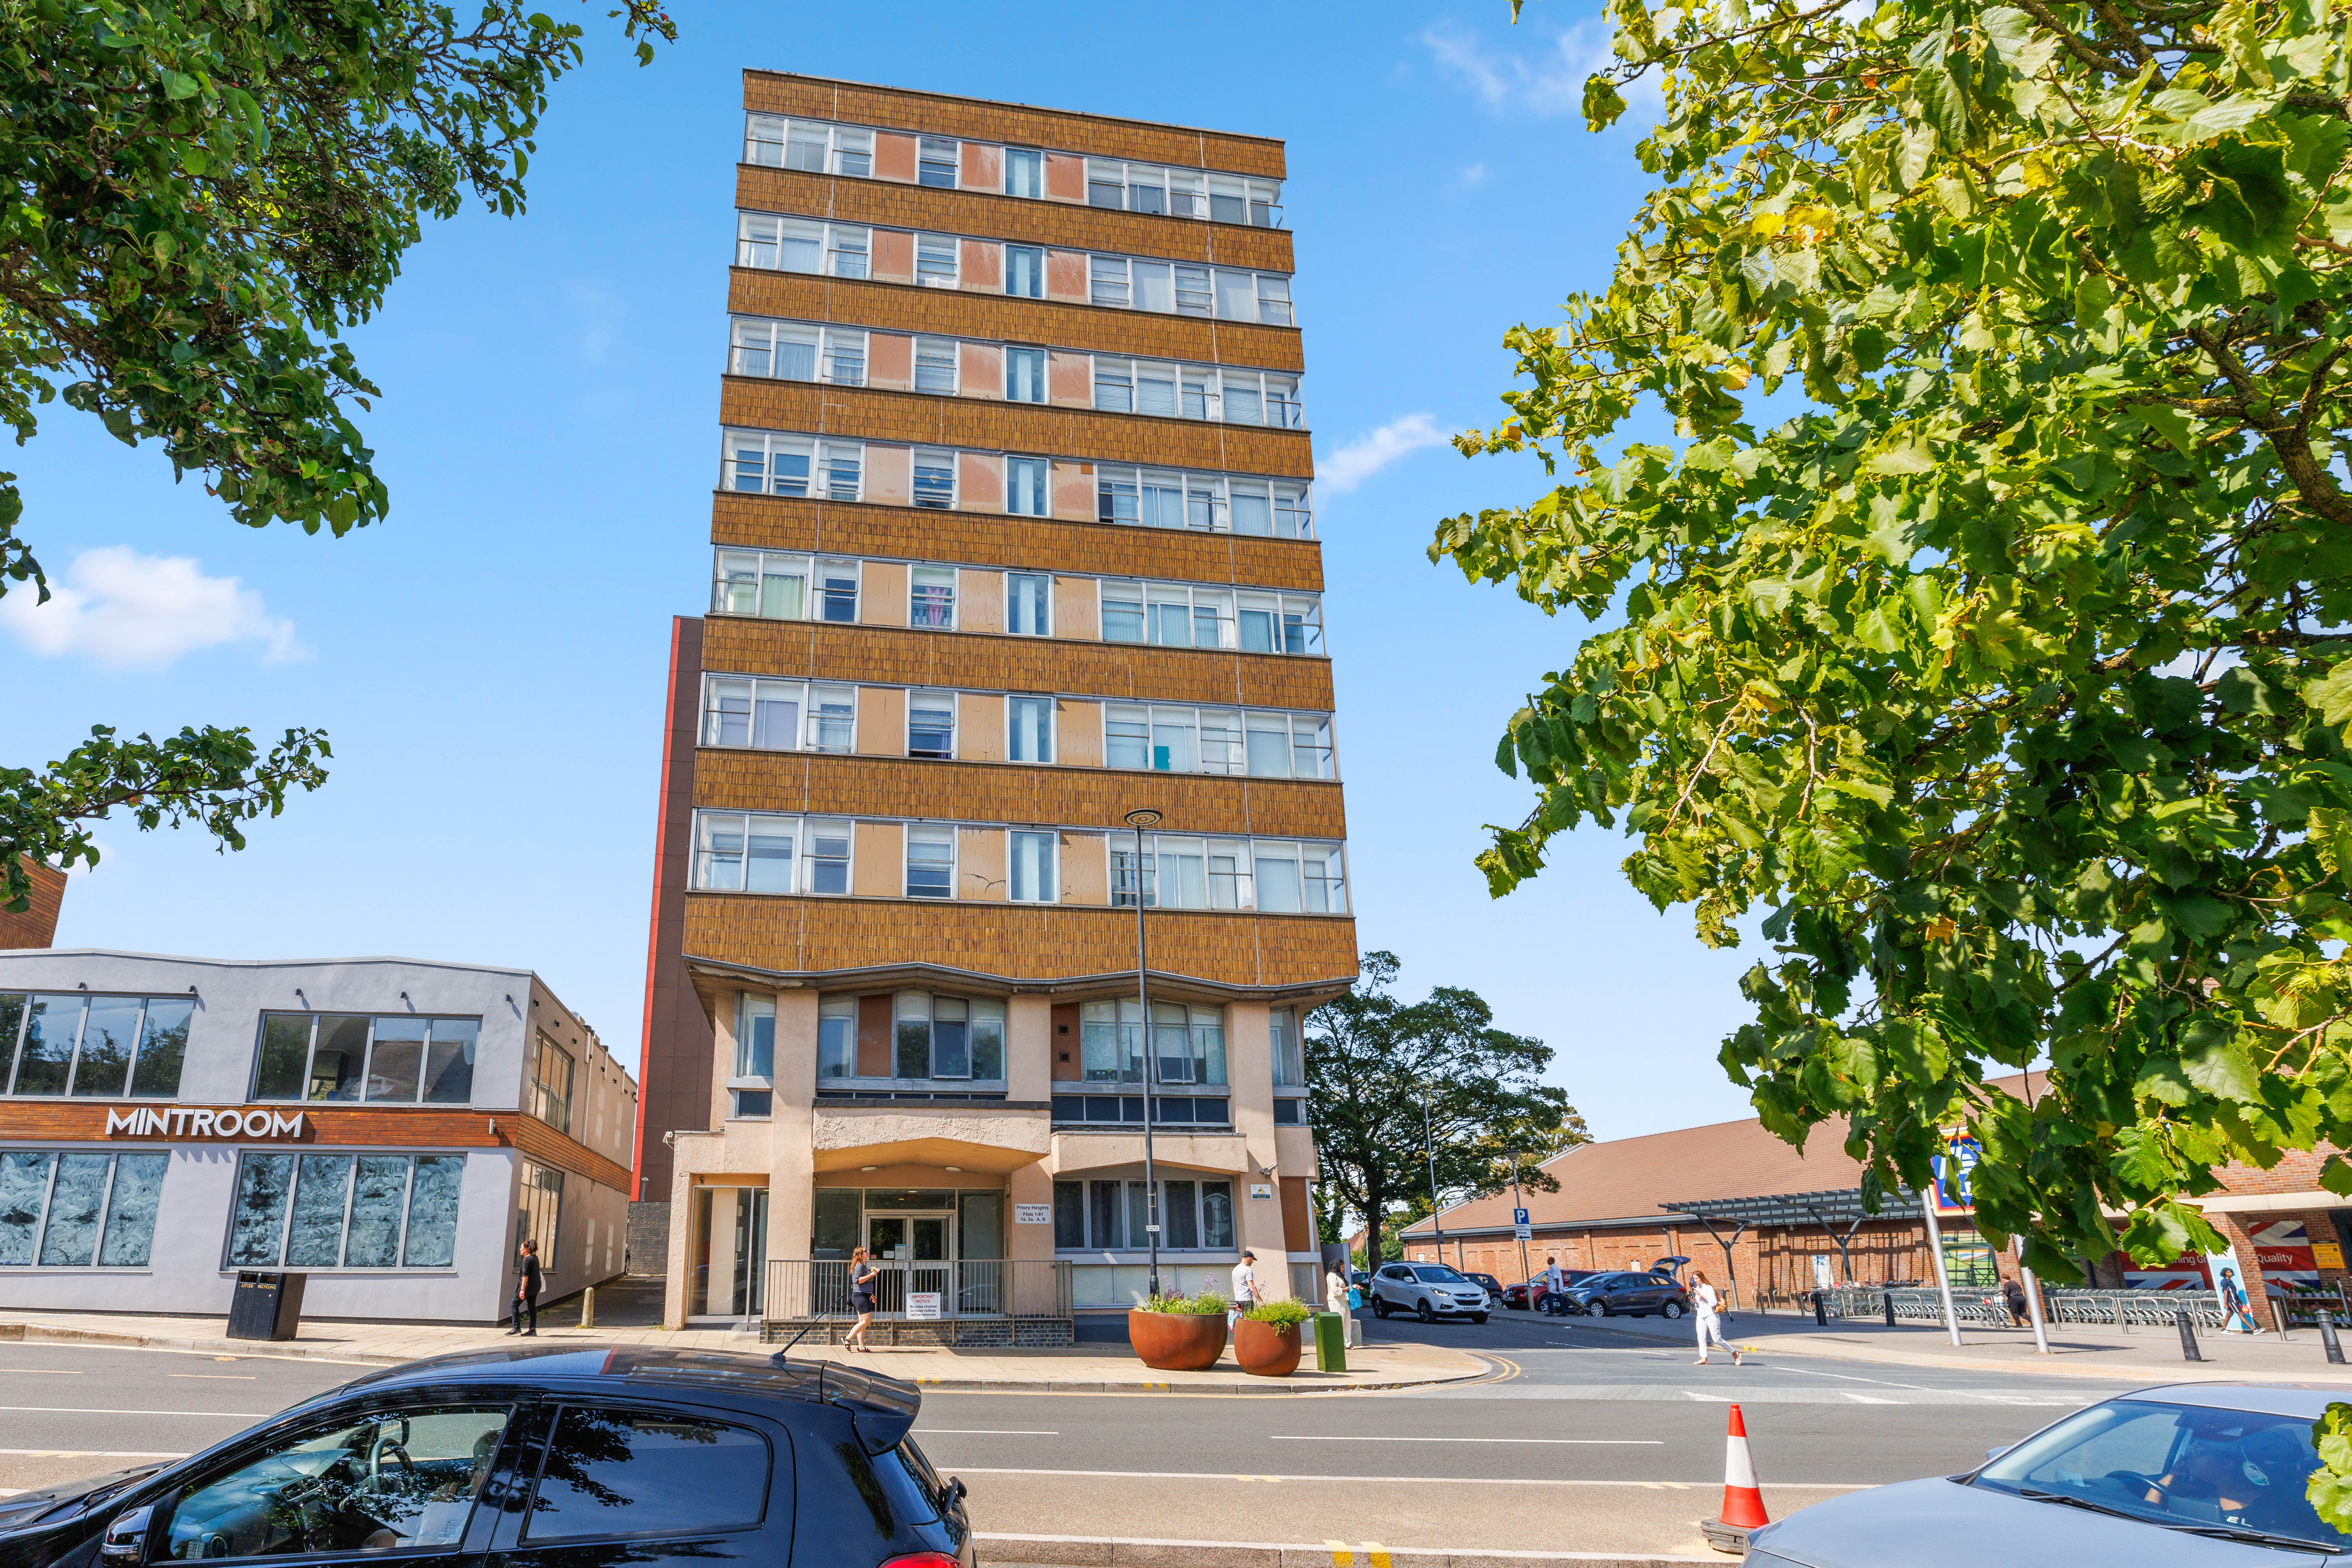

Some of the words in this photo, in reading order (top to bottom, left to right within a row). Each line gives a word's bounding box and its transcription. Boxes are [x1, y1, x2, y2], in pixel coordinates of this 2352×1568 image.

[105, 1107, 303, 1137] MINTROOM
[1517, 1210, 1525, 1223] P
[2257, 1253, 2292, 1264] Quality
